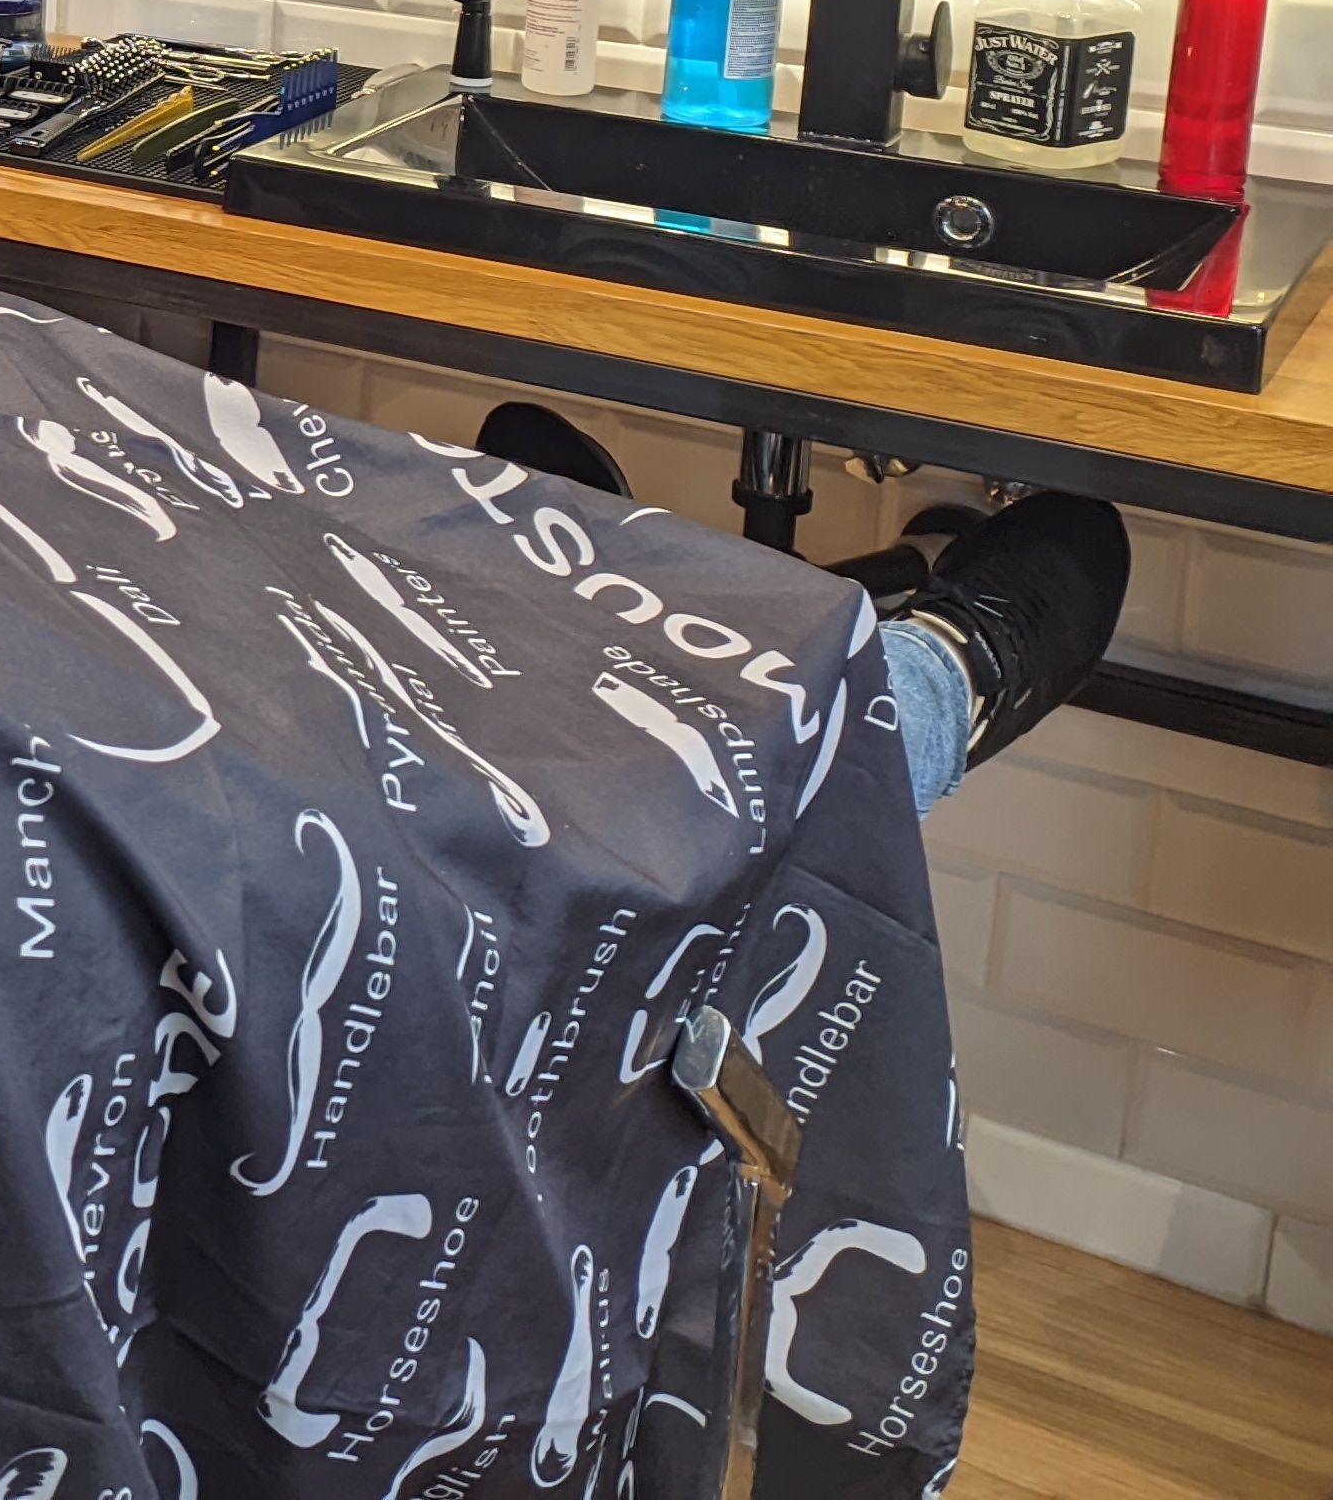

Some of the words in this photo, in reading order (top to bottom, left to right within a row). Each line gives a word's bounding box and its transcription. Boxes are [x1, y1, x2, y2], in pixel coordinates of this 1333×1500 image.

[975, 34, 1009, 52] JUST
[1009, 33, 1060, 66] WATER
[85, 563, 183, 626] Dali
[373, 549, 523, 680] Painters
[11, 734, 64, 959] Manch
[604, 643, 768, 855] Lampshade
[306, 865, 400, 1170] Handlebar
[524, 906, 639, 1176] oothbrush
[796, 959, 884, 1124] ndlebar
[327, 1195, 481, 1464] Horseshoe
[848, 1247, 971, 1458] Horseshoe
